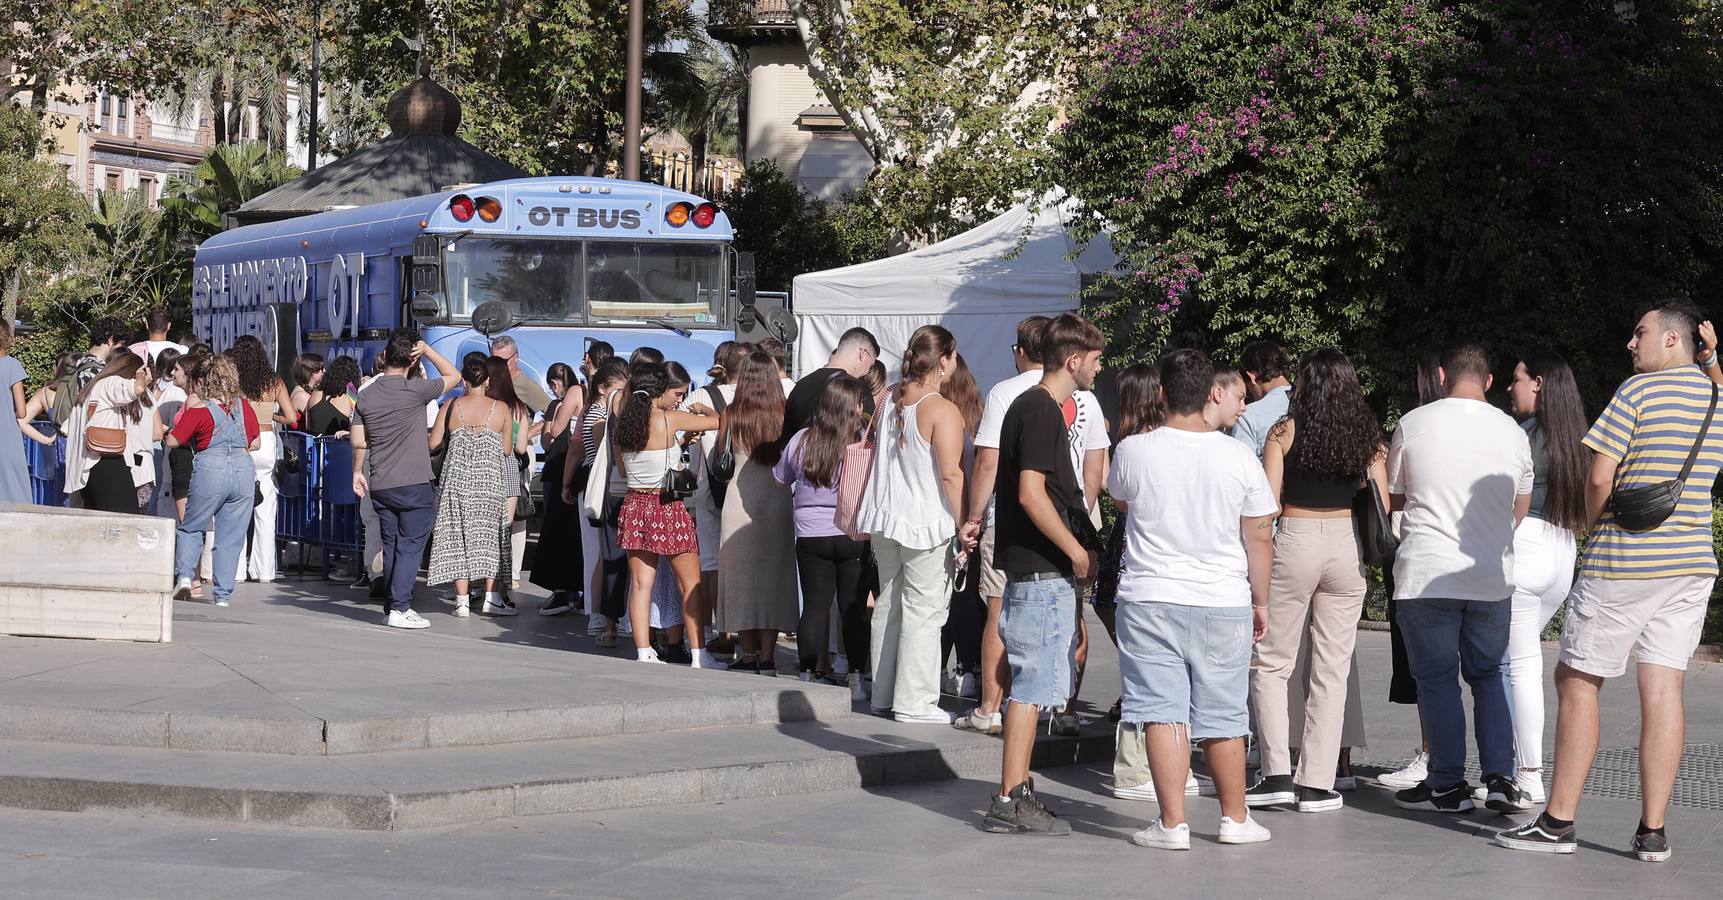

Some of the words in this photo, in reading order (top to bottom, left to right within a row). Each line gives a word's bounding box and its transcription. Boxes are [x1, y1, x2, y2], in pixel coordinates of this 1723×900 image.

[528, 205, 571, 227] OT
[577, 207, 642, 230] BUS
[192, 265, 211, 310] ES
[211, 264, 229, 308] EL
[229, 255, 309, 307] MOMENTO
[327, 252, 365, 339] OT
